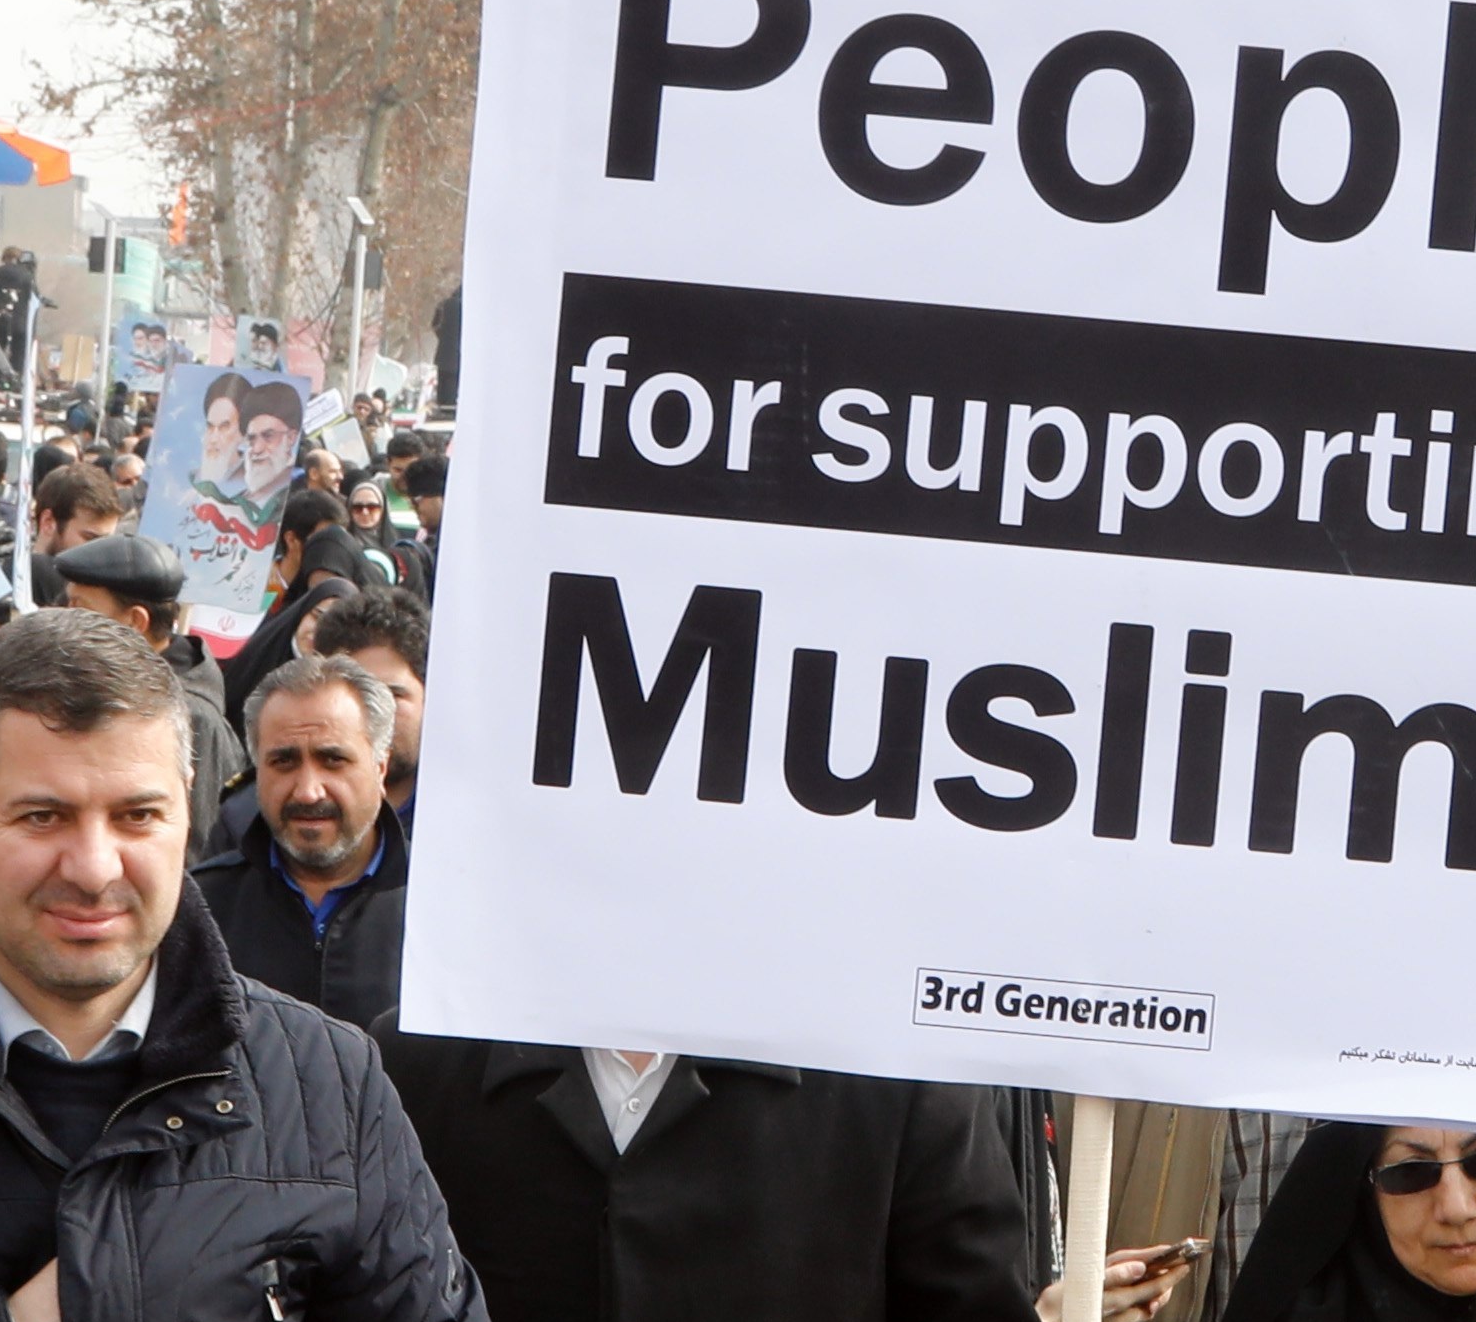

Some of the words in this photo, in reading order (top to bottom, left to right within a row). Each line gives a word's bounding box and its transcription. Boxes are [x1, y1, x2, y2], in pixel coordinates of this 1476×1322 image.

[571, 335, 782, 472] for
[921, 976, 986, 1014] 3rd
[995, 983, 1208, 1035] Generation
[1370, 1048, 1397, 1063] تشکر
[1397, 1050, 1442, 1064] مسلمانان
